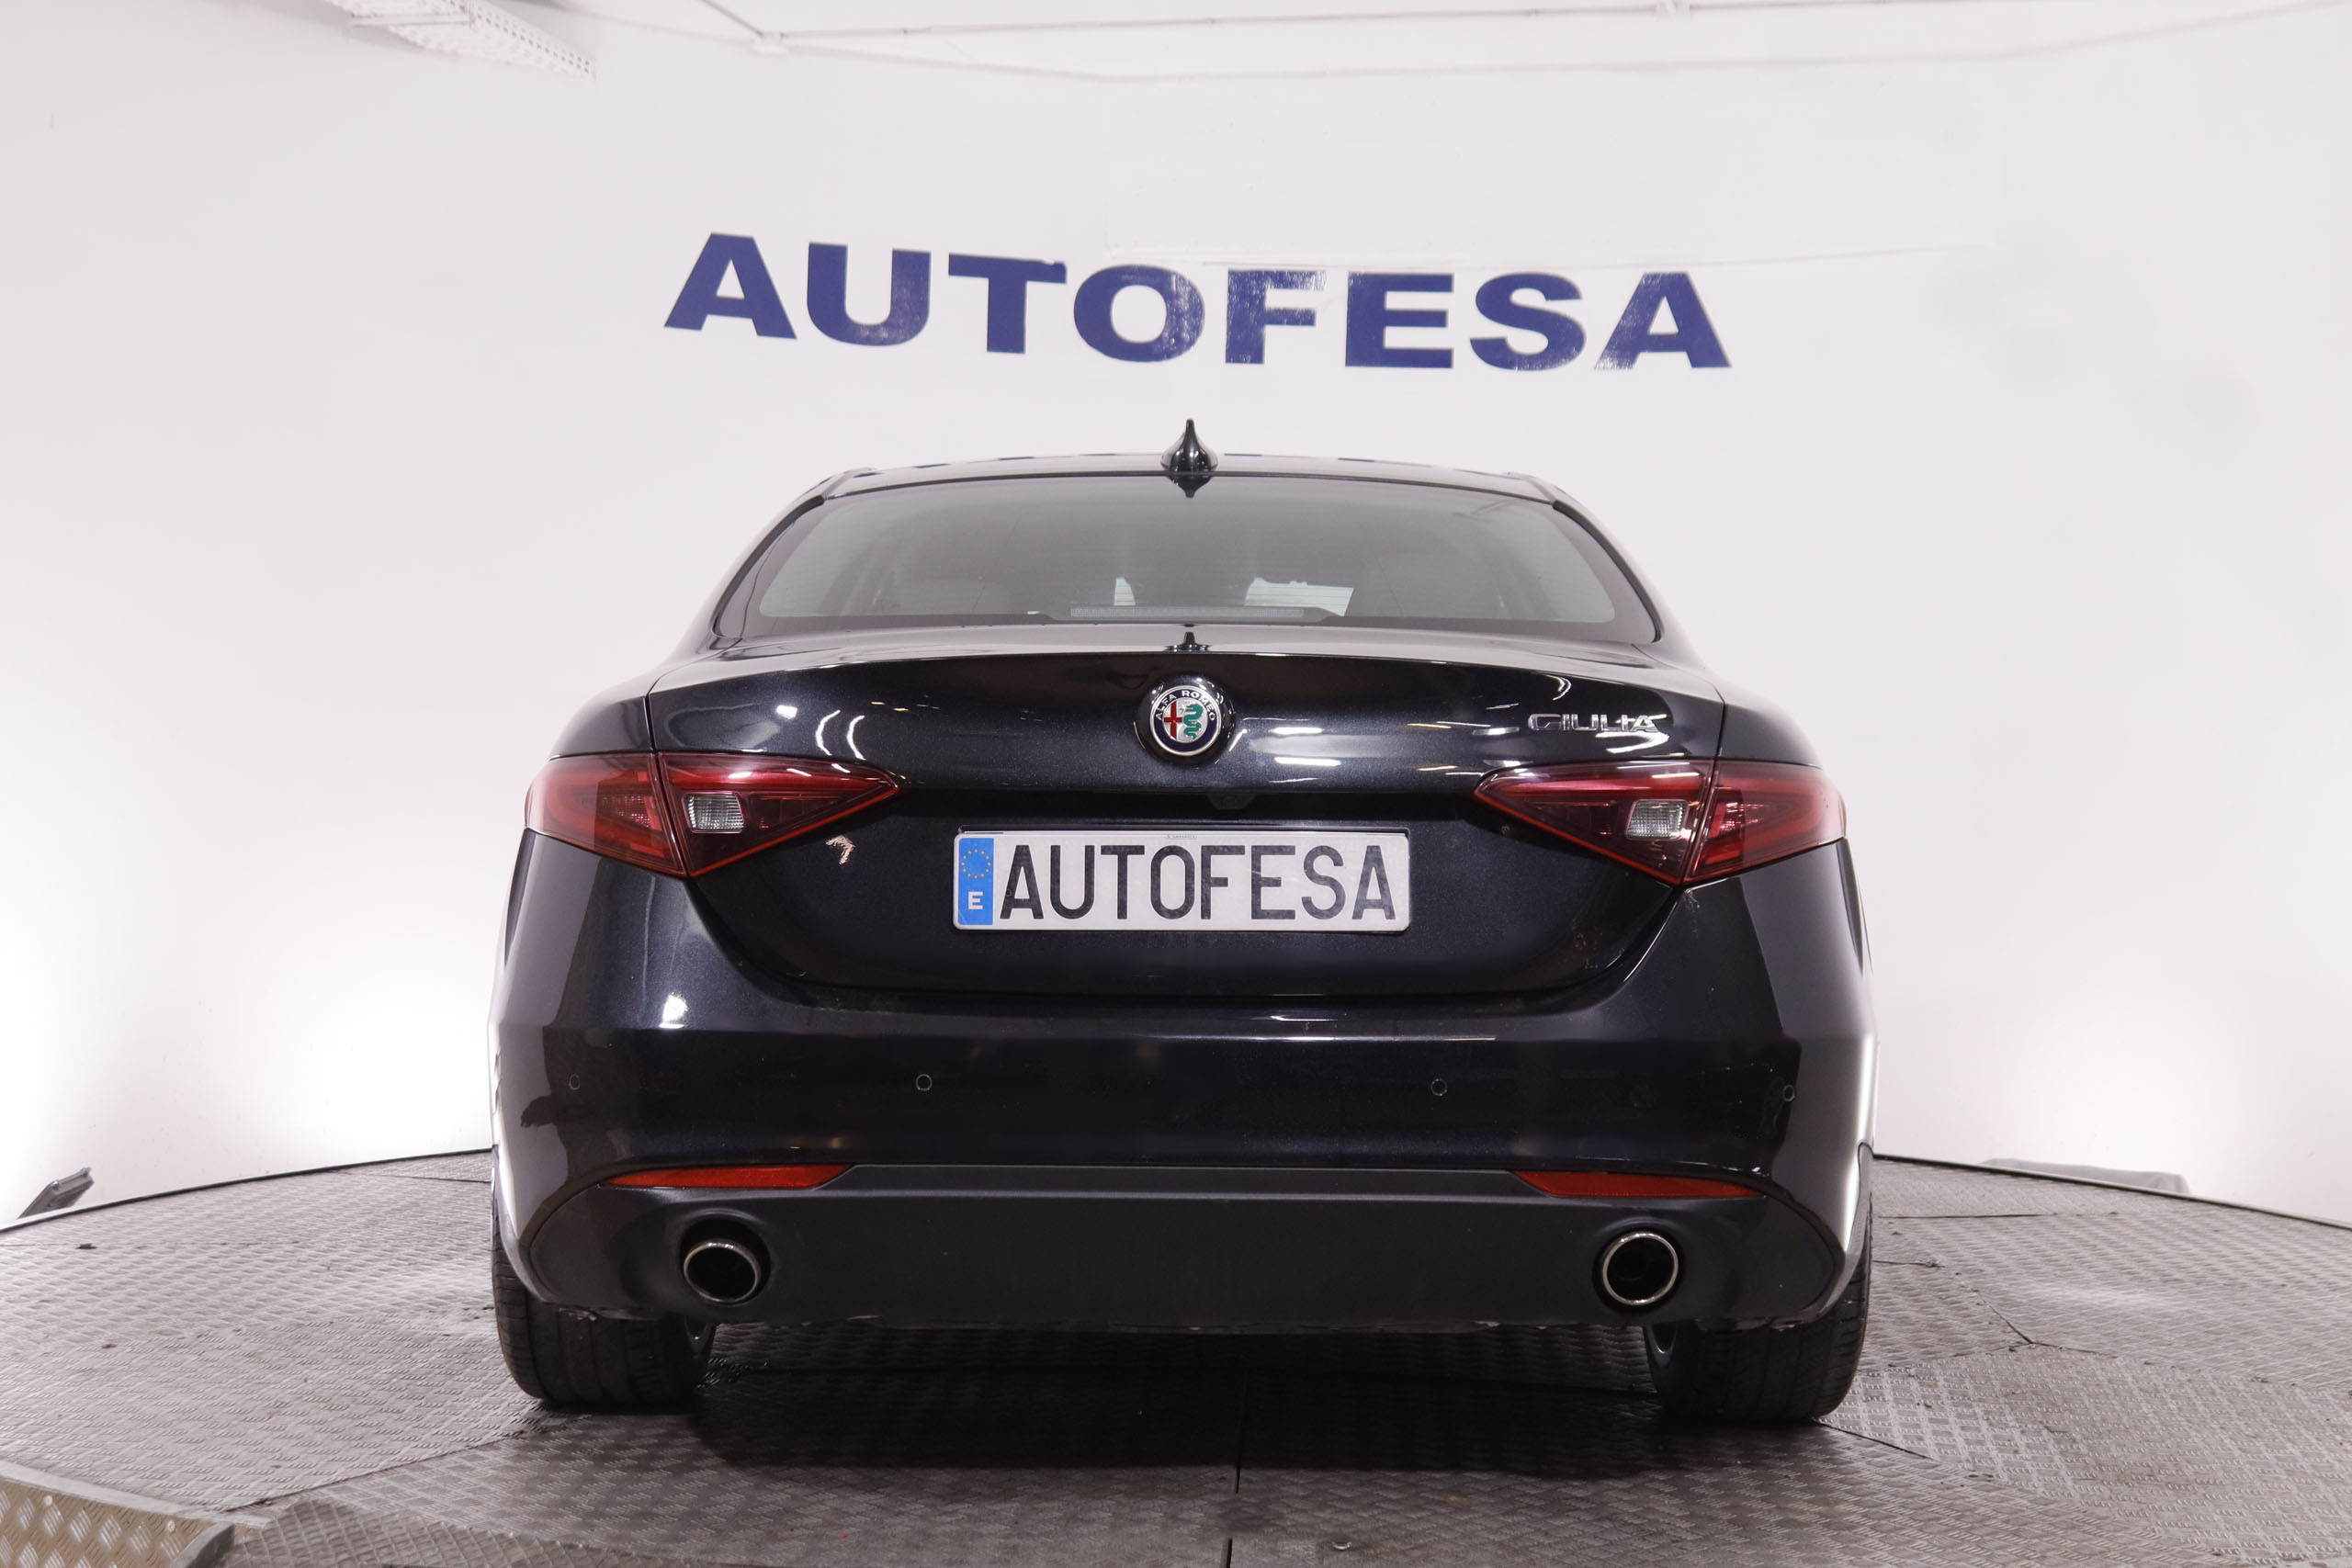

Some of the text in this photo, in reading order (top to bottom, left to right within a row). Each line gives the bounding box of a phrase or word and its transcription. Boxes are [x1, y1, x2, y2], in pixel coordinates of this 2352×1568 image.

[664, 232, 1731, 370] AUTOFESA
[1155, 690, 1216, 721] ALFA ROMEO
[1528, 713, 1659, 732] GIULIA
[1000, 844, 1396, 919] AUTOFESA
[967, 891, 983, 910] E
